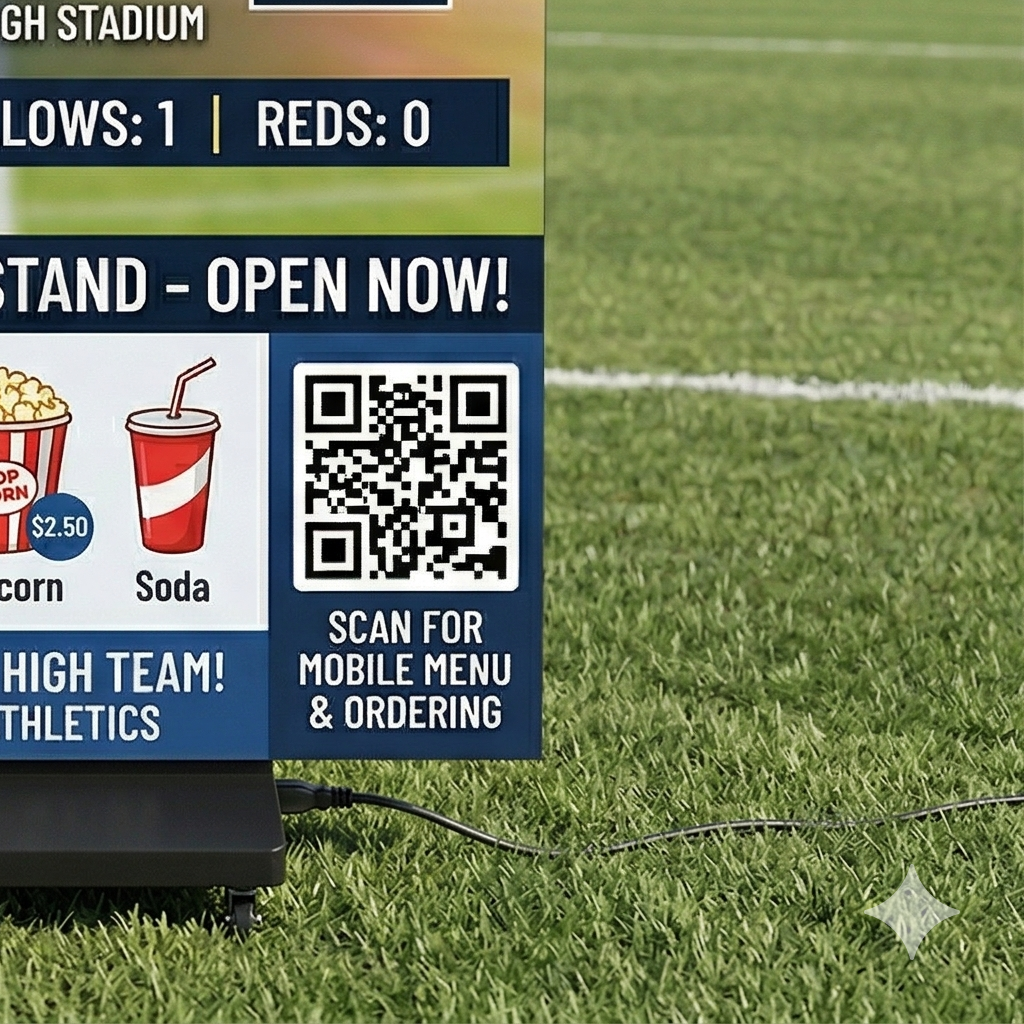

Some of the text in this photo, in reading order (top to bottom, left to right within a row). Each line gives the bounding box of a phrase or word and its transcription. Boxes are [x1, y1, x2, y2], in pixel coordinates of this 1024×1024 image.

[57, 4, 204, 41] STADIUM
[158, 100, 173, 146] 1
[258, 100, 429, 147] REDS: 0
[207, 257, 346, 313] OPEN
[368, 257, 508, 313] NOW!
[32, 515, 88, 541] $2.50
[135, 570, 210, 603] Soda
[329, 610, 482, 644] SCAN FOR
[3, 651, 92, 693] HIGH
[106, 652, 224, 693] TEAM!
[300, 653, 511, 686] MOBILE MENU
[309, 695, 501, 729] & ORDERING
